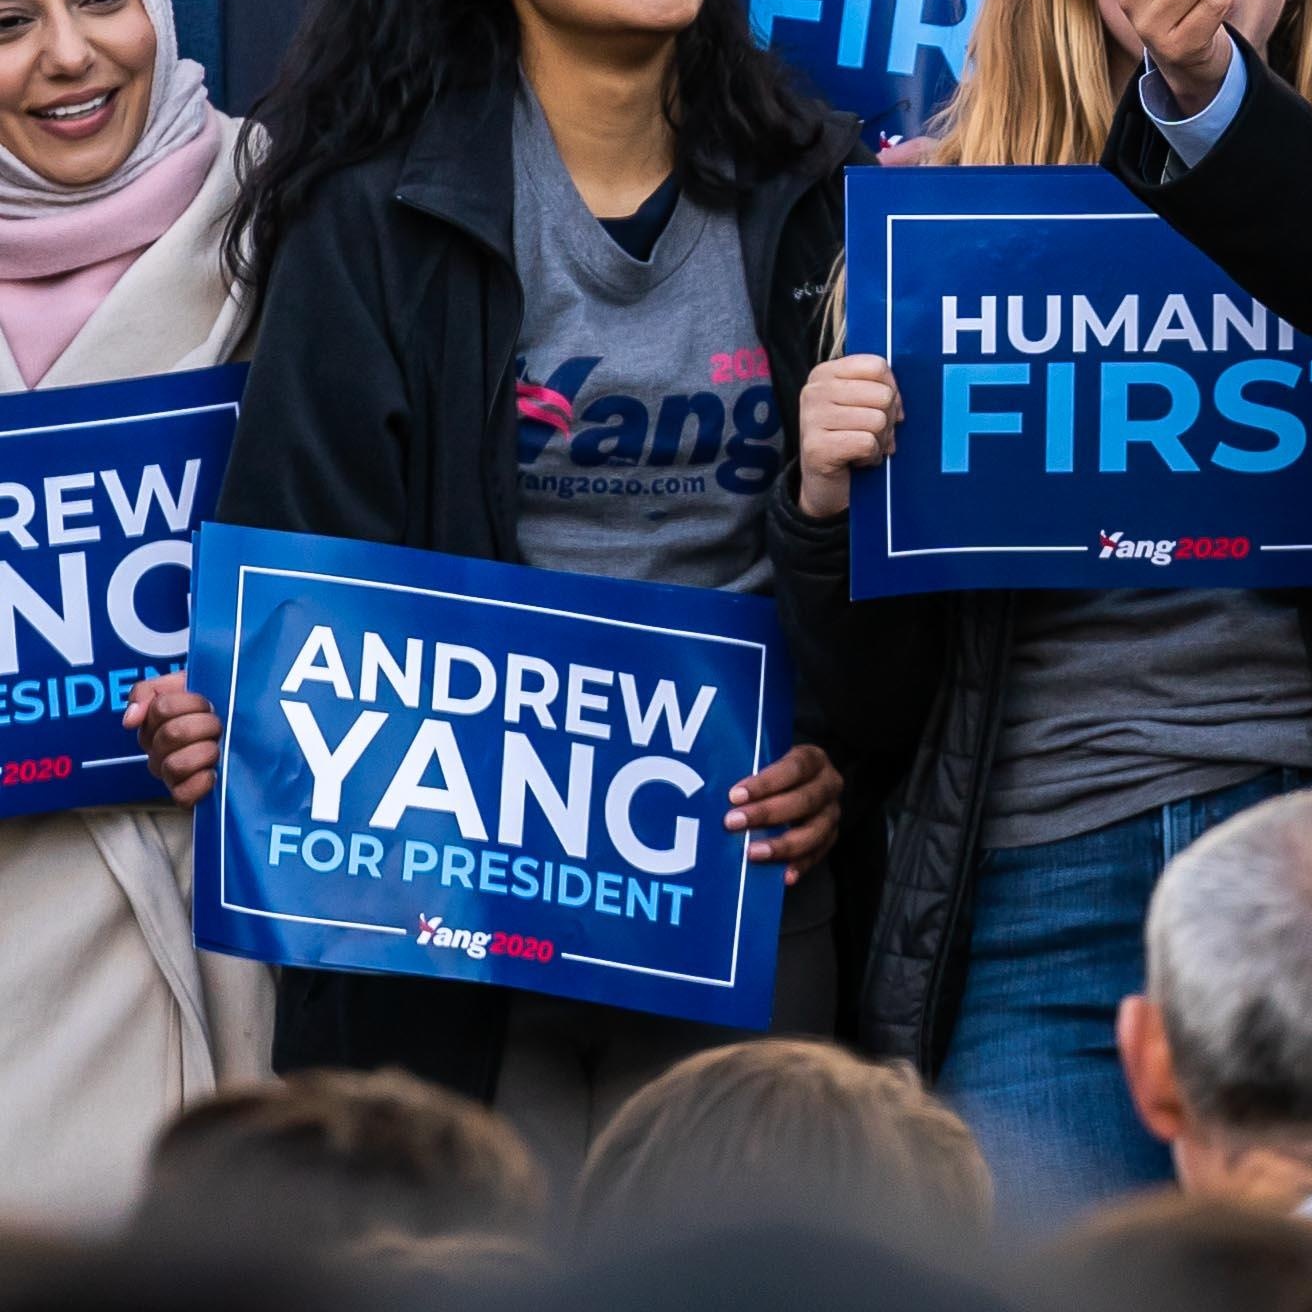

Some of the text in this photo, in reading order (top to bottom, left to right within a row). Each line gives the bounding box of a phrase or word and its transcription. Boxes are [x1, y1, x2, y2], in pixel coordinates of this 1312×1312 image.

[280, 624, 719, 754] ANDREW
[279, 698, 706, 876] YANG
[268, 823, 694, 927] FOR PRESIDENT
